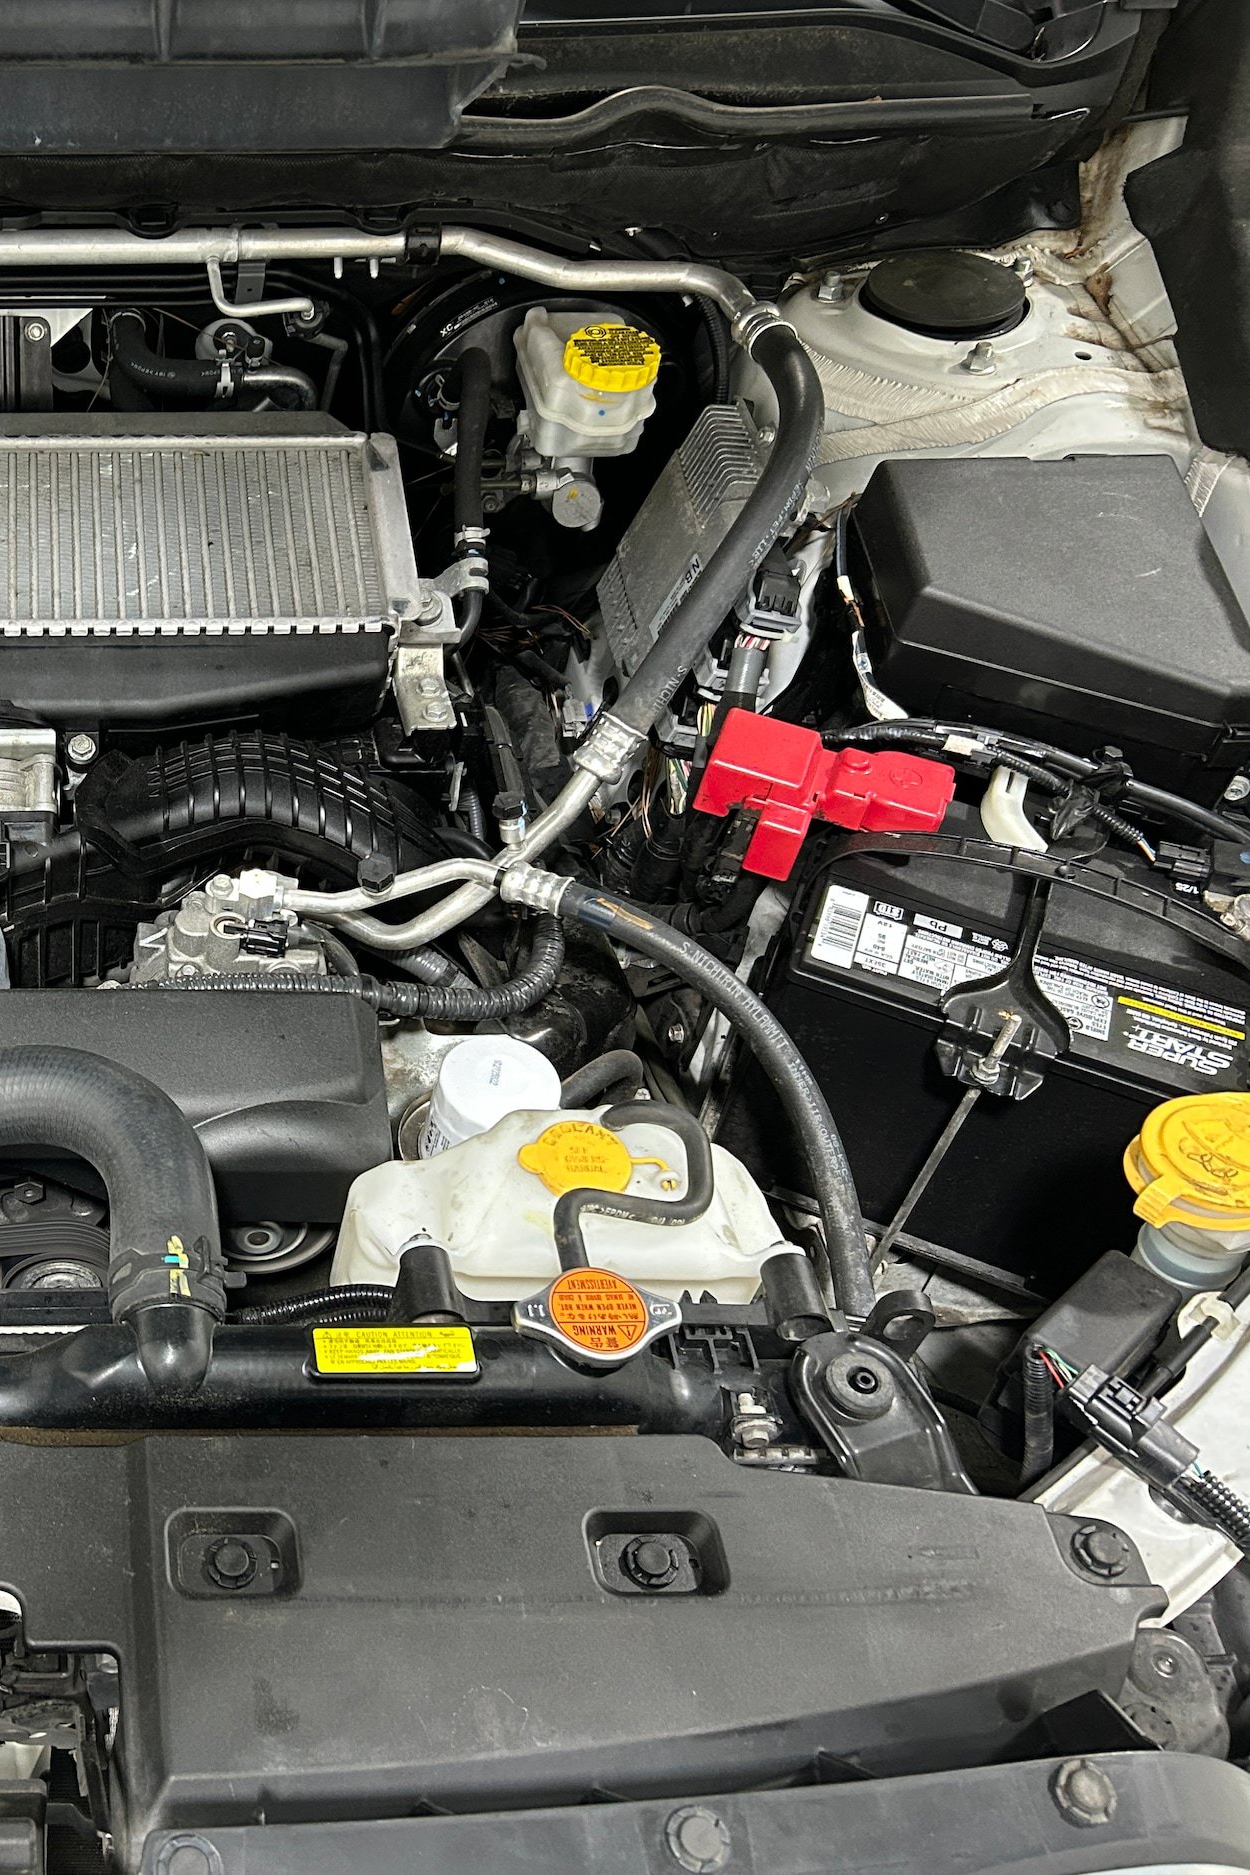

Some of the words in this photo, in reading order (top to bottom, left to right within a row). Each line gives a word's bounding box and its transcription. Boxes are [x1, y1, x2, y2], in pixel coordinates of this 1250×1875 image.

[440, 323, 454, 337] XC
[1174, 882, 1199, 893] 1/25
[876, 904, 900, 916] STD
[928, 918, 948, 932] Pb
[741, 995, 789, 1052] HYLAMMIT
[1126, 1038, 1218, 1076] SUPER
[527, 1303, 545, 1317] 1.1
[572, 1325, 616, 1335] WARNING
[589, 1336, 618, 1348] 警告
